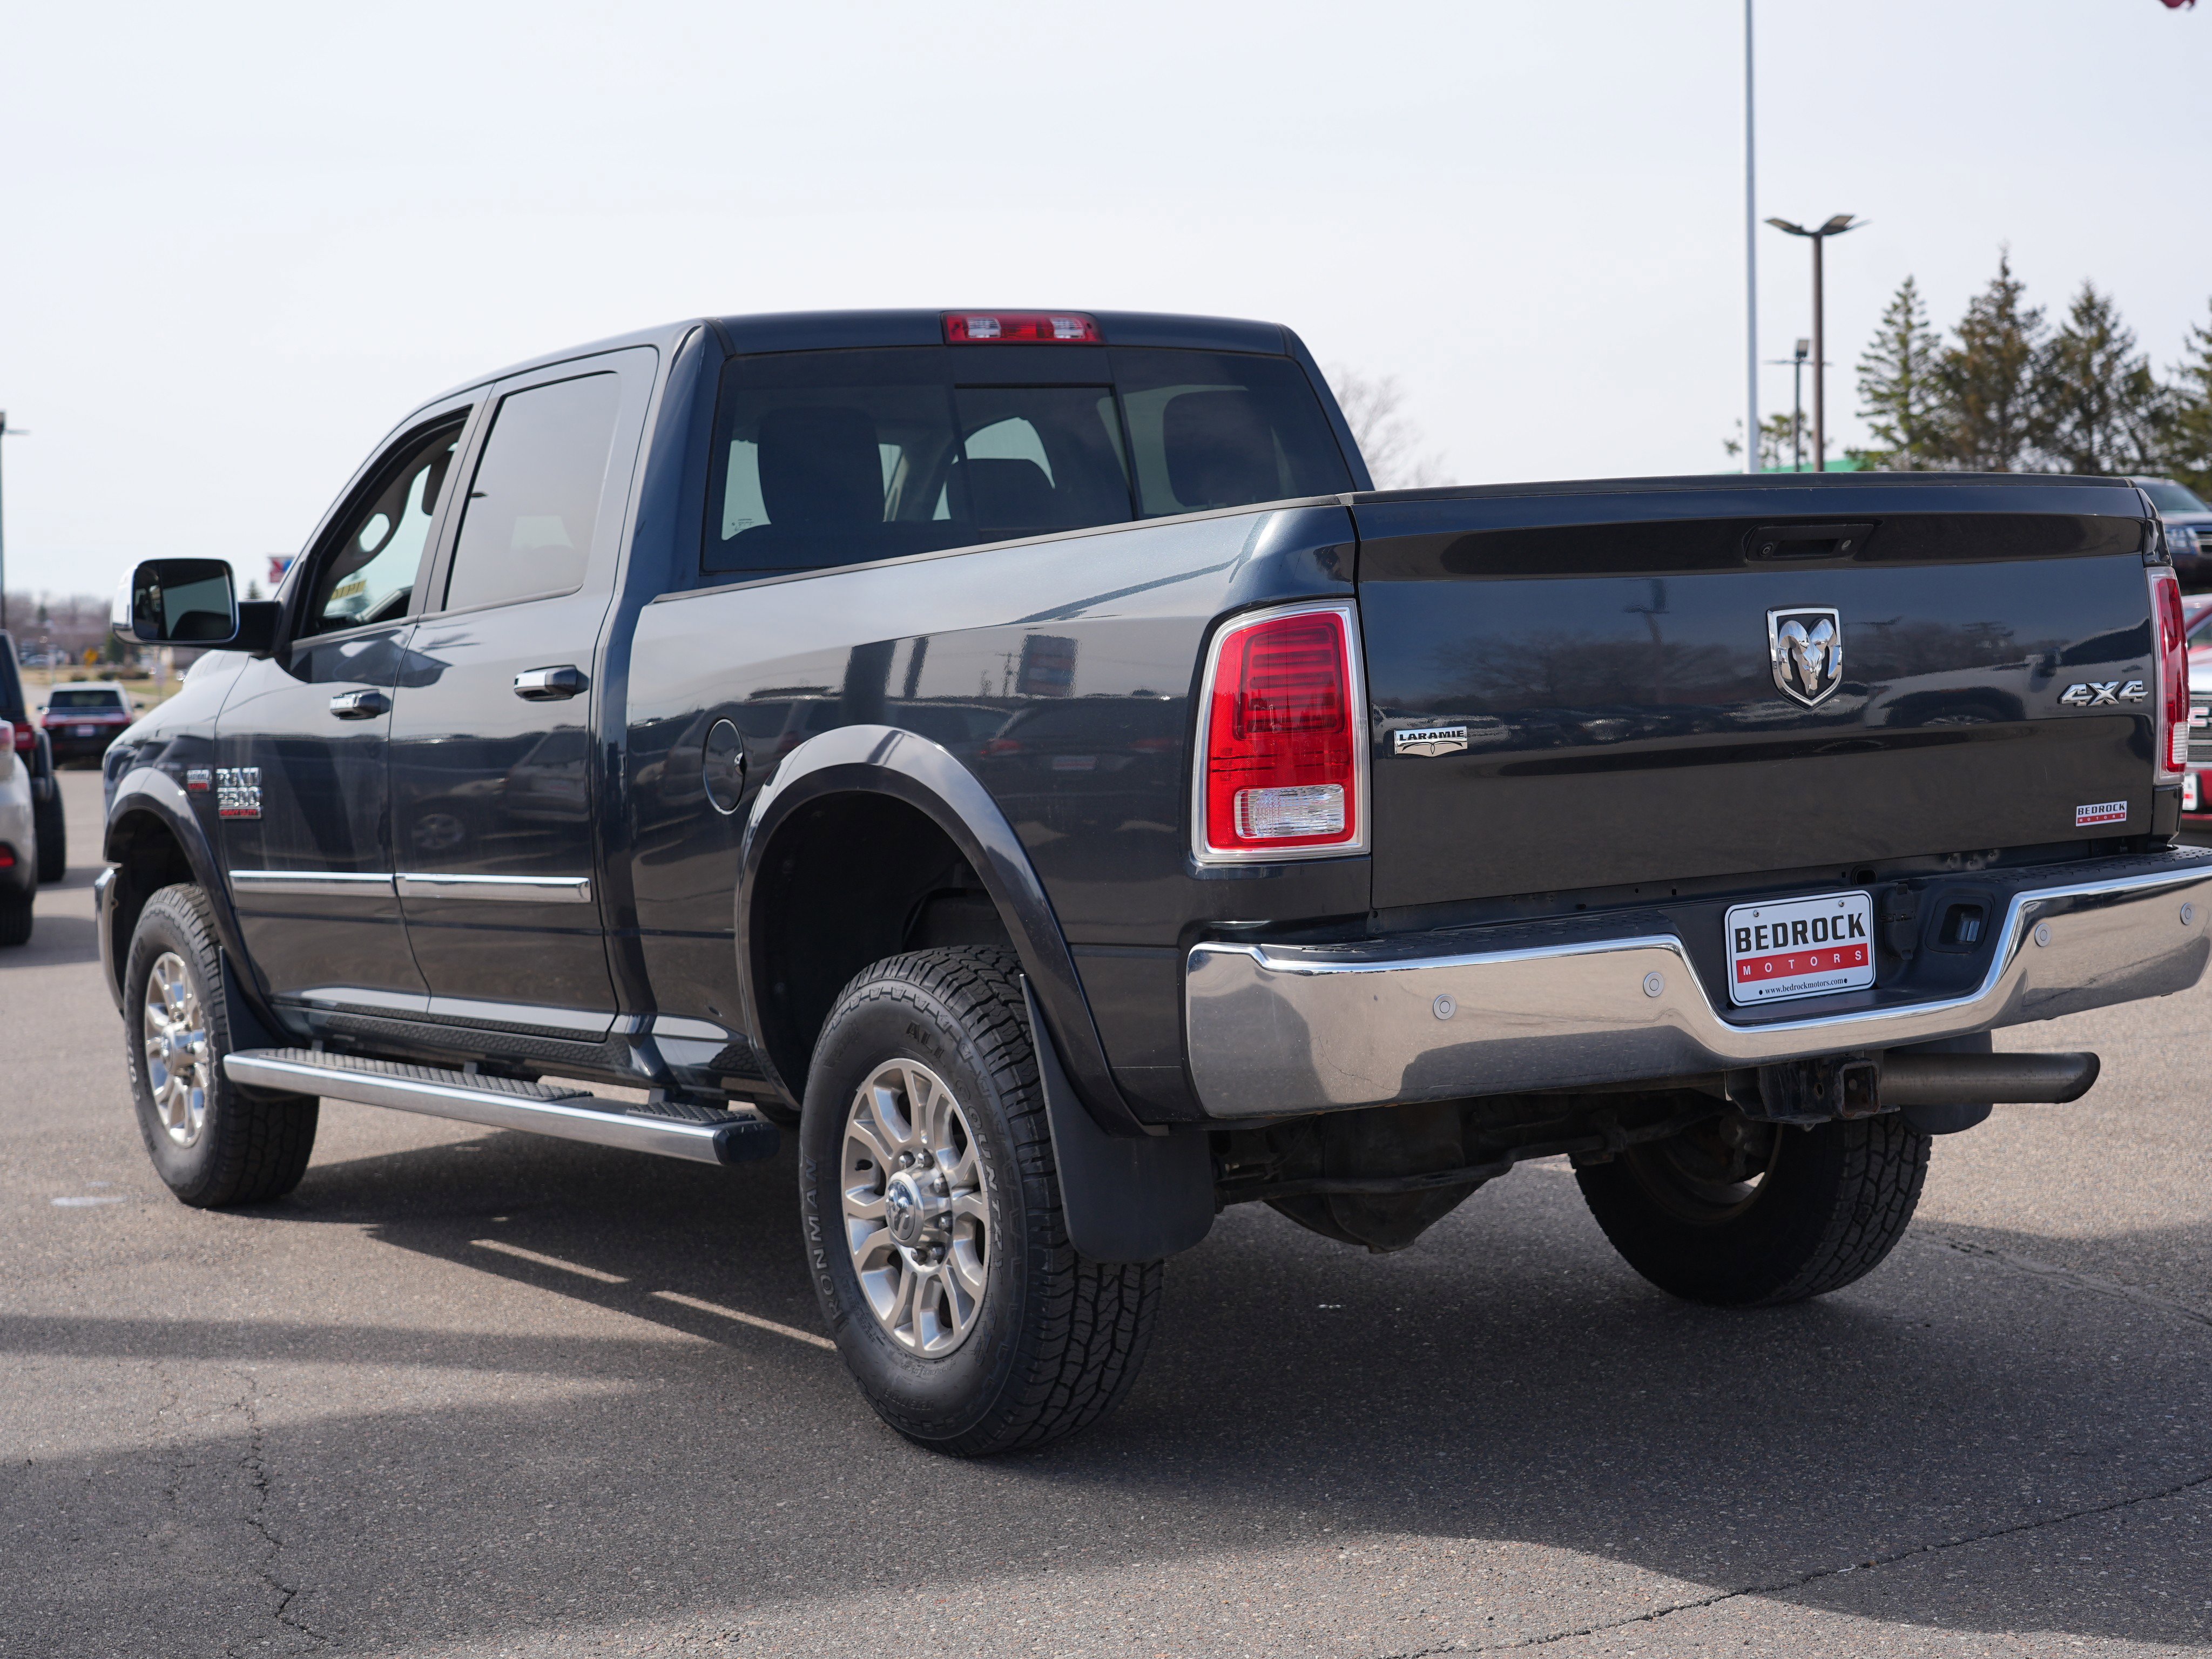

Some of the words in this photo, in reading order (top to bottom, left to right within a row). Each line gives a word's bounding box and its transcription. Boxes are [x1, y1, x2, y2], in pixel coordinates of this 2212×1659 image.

[1399, 730, 1464, 740] LARAMIE
[2078, 803, 2125, 815] BEDROCK
[2079, 814, 2123, 822] MOTORS
[1735, 913, 1865, 953] BEDROCK
[1743, 950, 1862, 975] MOTORS
[1765, 978, 1844, 994] www.bedrockmotors.com
[907, 1020, 946, 1068] ALL
[955, 1079, 1003, 1283] COUNTRY
[805, 1155, 849, 1332] IRONMAN
